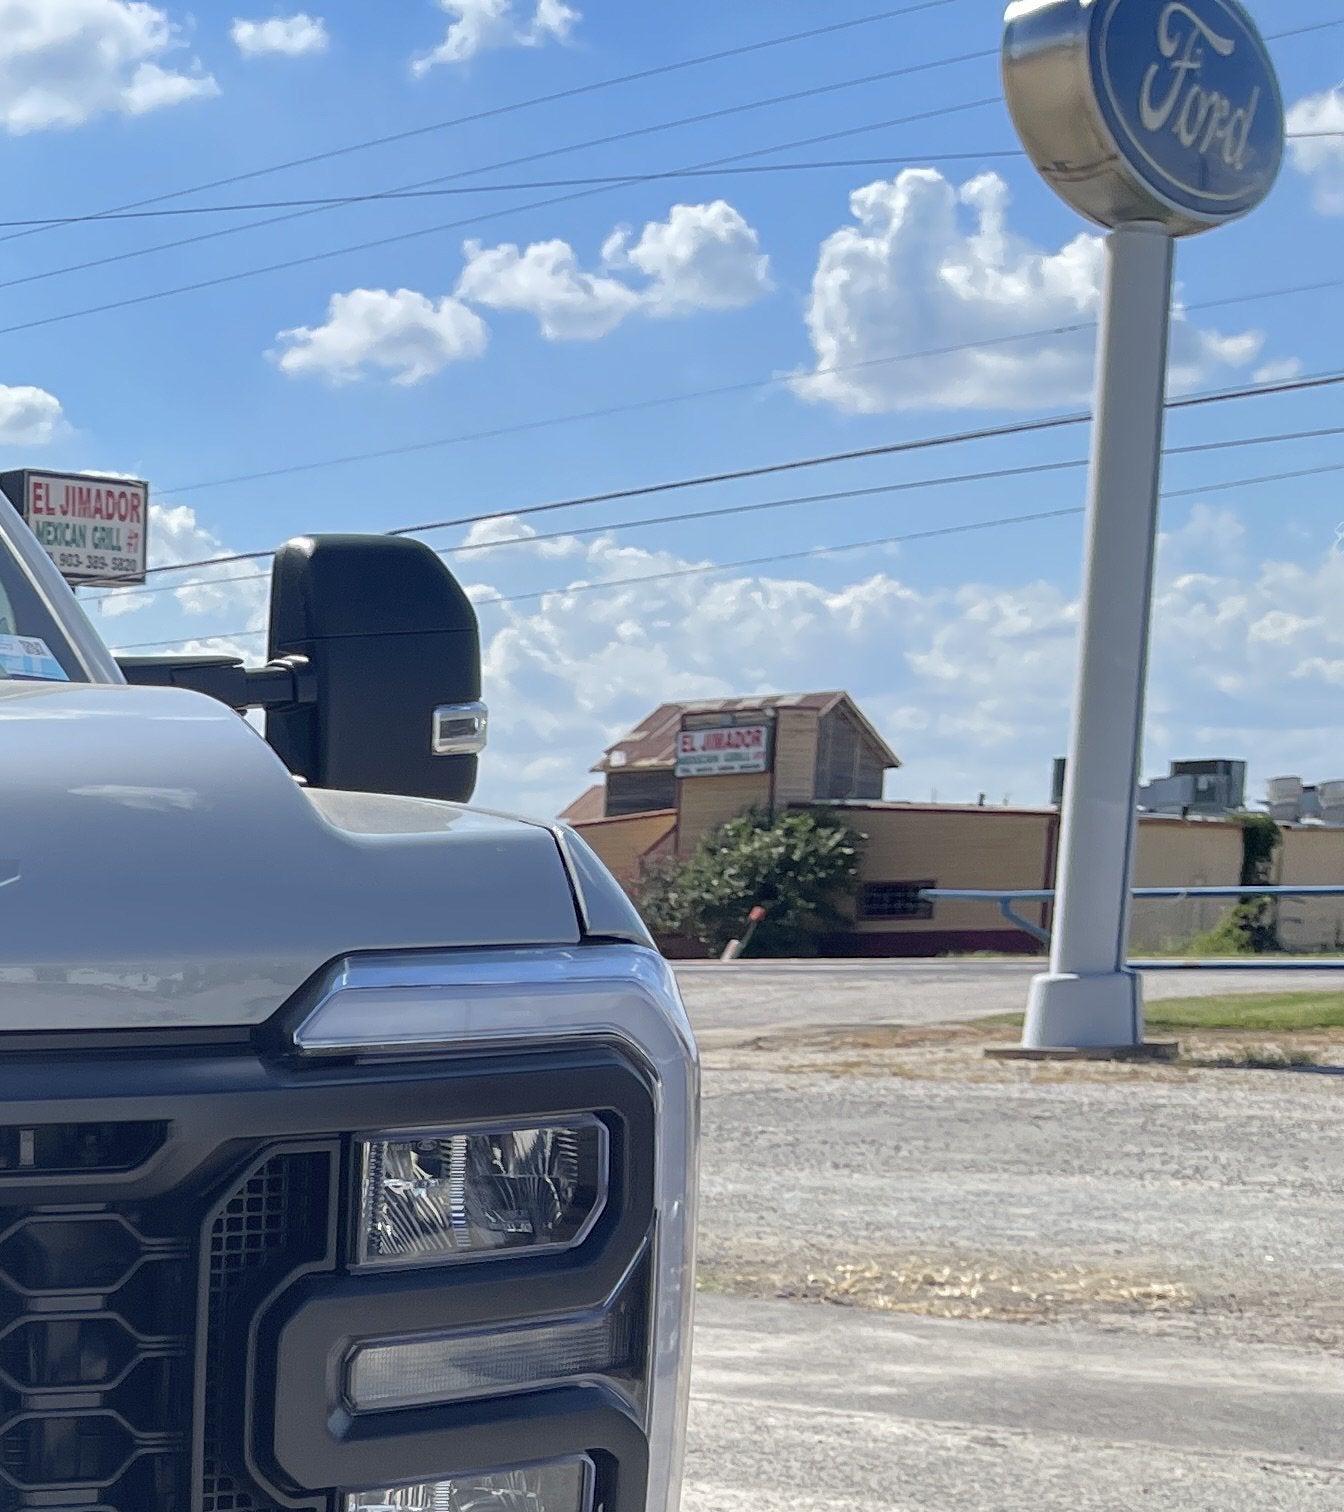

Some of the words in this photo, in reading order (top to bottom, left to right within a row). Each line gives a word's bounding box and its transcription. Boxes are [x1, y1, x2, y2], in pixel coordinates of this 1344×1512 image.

[1139, 3, 1260, 171] Ford
[33, 482, 55, 516] EL
[59, 485, 141, 524] JIMADOR
[35, 521, 87, 549] MEXICAN
[92, 525, 122, 552] GRILL
[681, 734, 695, 753] EL
